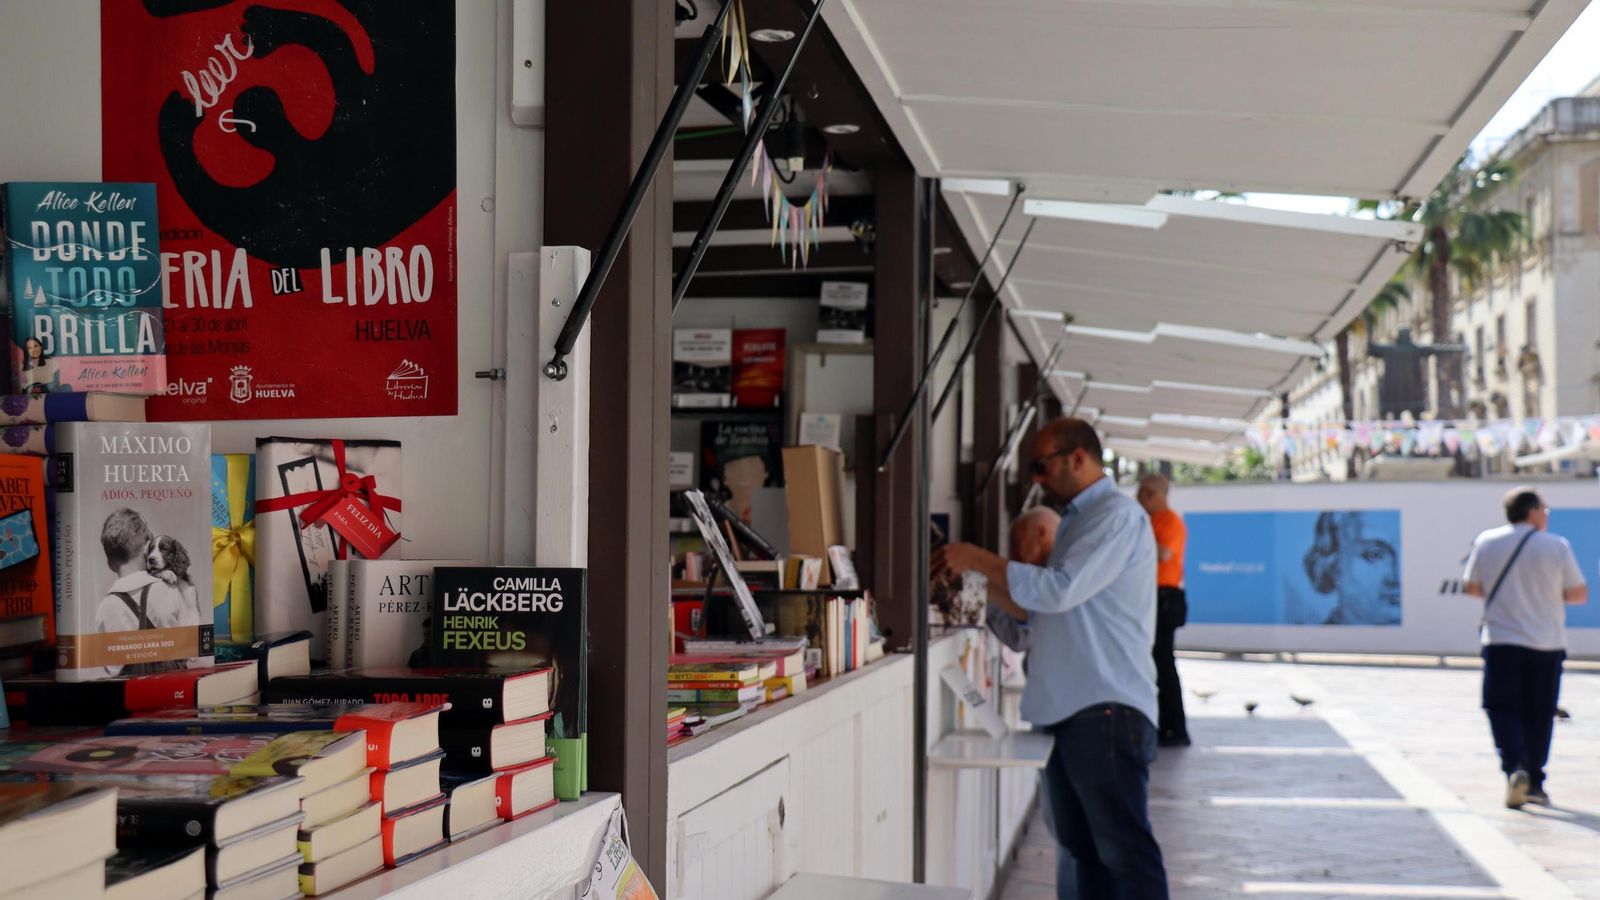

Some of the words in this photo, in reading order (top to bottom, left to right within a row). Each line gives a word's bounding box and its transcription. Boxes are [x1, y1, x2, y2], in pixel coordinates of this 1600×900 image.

[35, 190, 80, 212] Alice
[83, 191, 137, 213] Kellen
[31, 220, 148, 261] DONDE
[45, 266, 137, 307] TODO
[160, 247, 253, 310] ERIA
[271, 267, 301, 295] DEL
[320, 244, 434, 306] LIBRO
[34, 312, 157, 355] BRILLA
[190, 317, 206, 332] 30
[208, 317, 221, 332] de
[223, 316, 248, 332] abril
[355, 319, 432, 342] HUELVA
[160, 378, 207, 396] elva
[256, 389, 295, 398] HUELVA
[101, 431, 192, 454] MÁXIMO
[103, 464, 191, 483] HUERTA
[101, 487, 138, 500] ADIÓS,
[141, 486, 192, 501] PEQUEÑO
[333, 511, 349, 527] PARA
[346, 503, 369, 526] FELIZ
[367, 522, 383, 540] DÍA
[379, 574, 429, 596] ART
[494, 577, 562, 592] CAMILLA
[443, 588, 564, 613] LÄCKBERG
[443, 616, 499, 630] HENRIK
[108, 643, 143, 652] FERNANDO
[143, 641, 160, 649] LARA
[443, 631, 526, 651] FEXEUS
